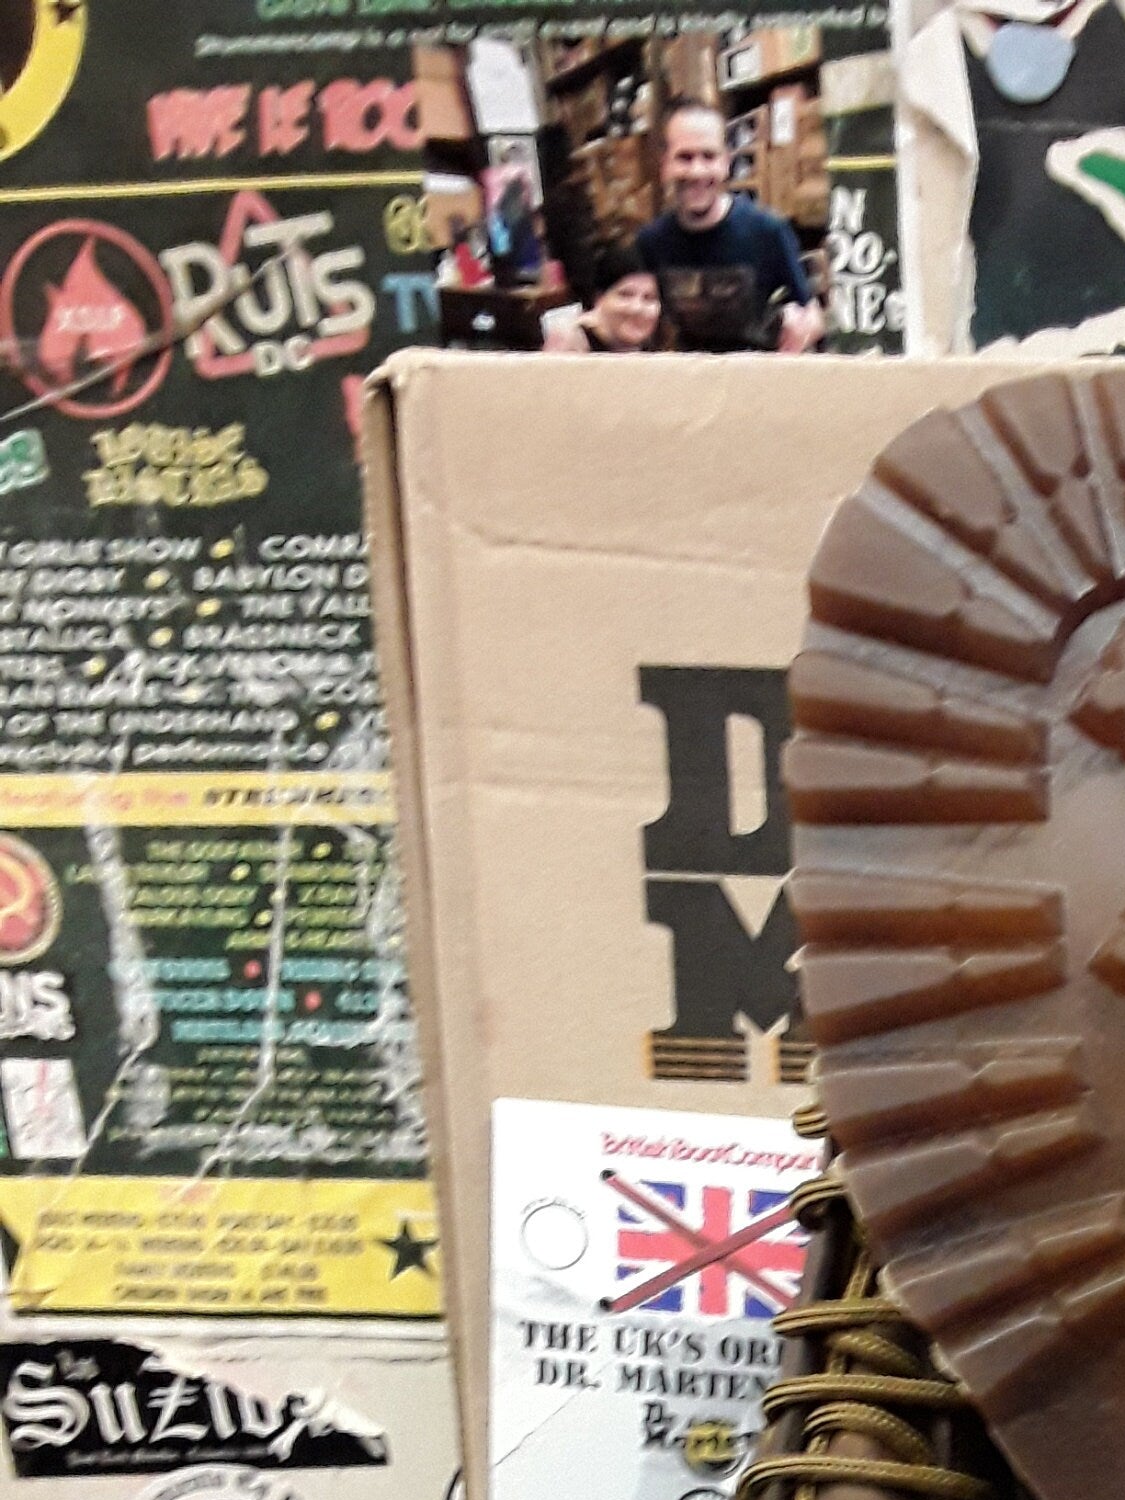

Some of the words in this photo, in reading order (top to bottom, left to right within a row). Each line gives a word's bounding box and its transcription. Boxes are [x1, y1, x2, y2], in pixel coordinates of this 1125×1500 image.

[520, 1320, 600, 1353] THE
[615, 1325, 706, 1361] UK'S
[536, 1357, 601, 1389] DR.
